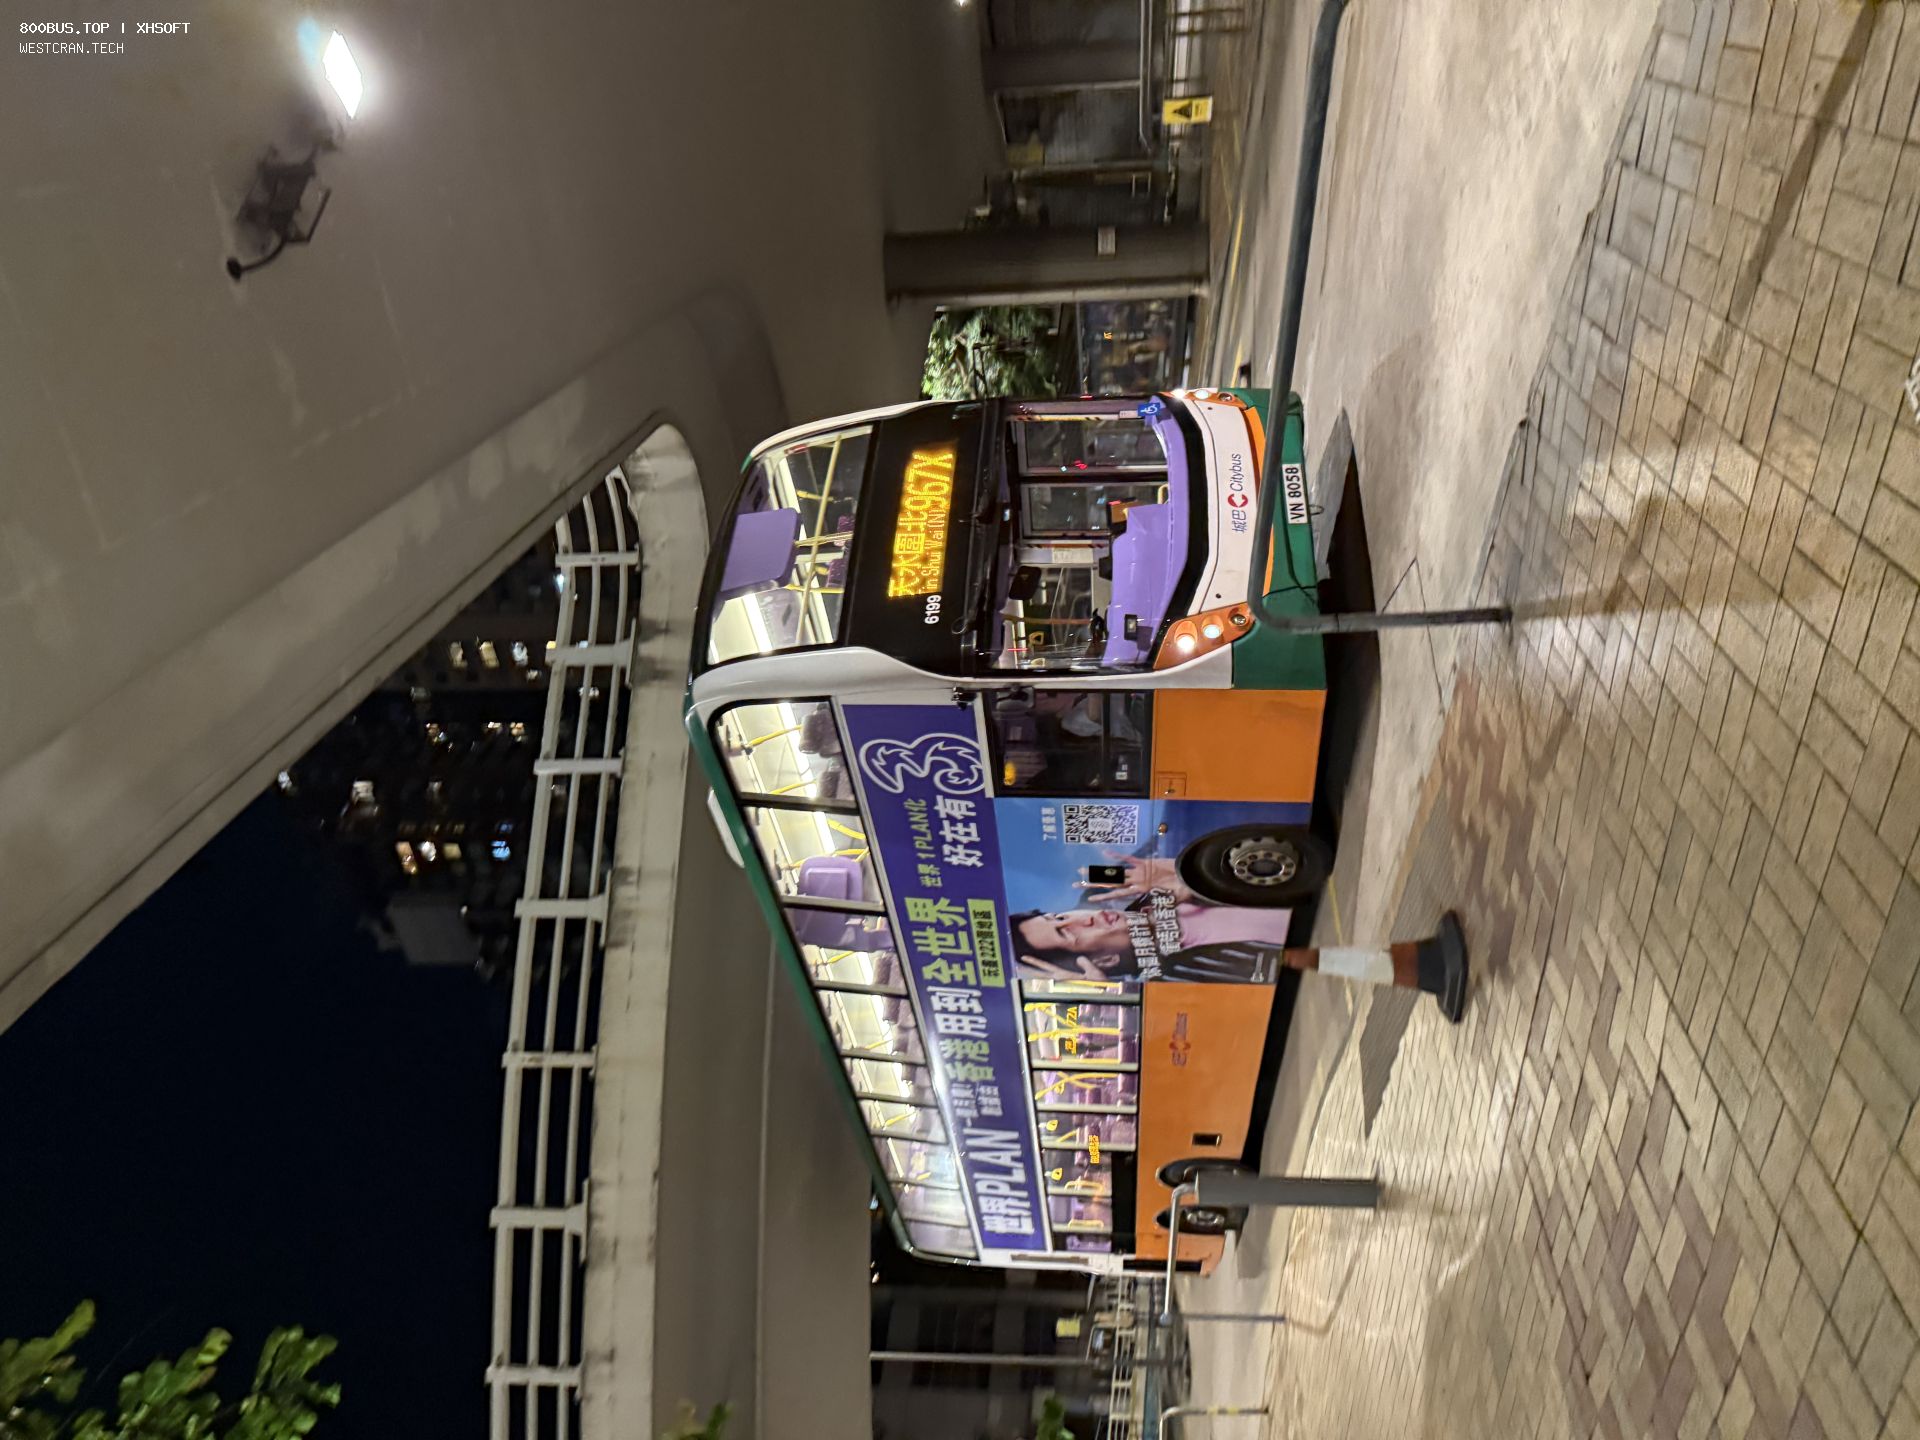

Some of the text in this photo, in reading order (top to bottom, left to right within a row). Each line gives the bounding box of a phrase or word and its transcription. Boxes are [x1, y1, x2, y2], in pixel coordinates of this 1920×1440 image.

[901, 451, 953, 511] 967X
[1228, 453, 1245, 492] Citybus
[1284, 467, 1305, 520] VN 8058
[926, 510, 947, 528] (N)
[888, 511, 929, 597] 天水圍北
[924, 530, 945, 549] Wai
[921, 551, 942, 576] Shui
[924, 594, 942, 625] 6199
[932, 794, 985, 868] 好在有
